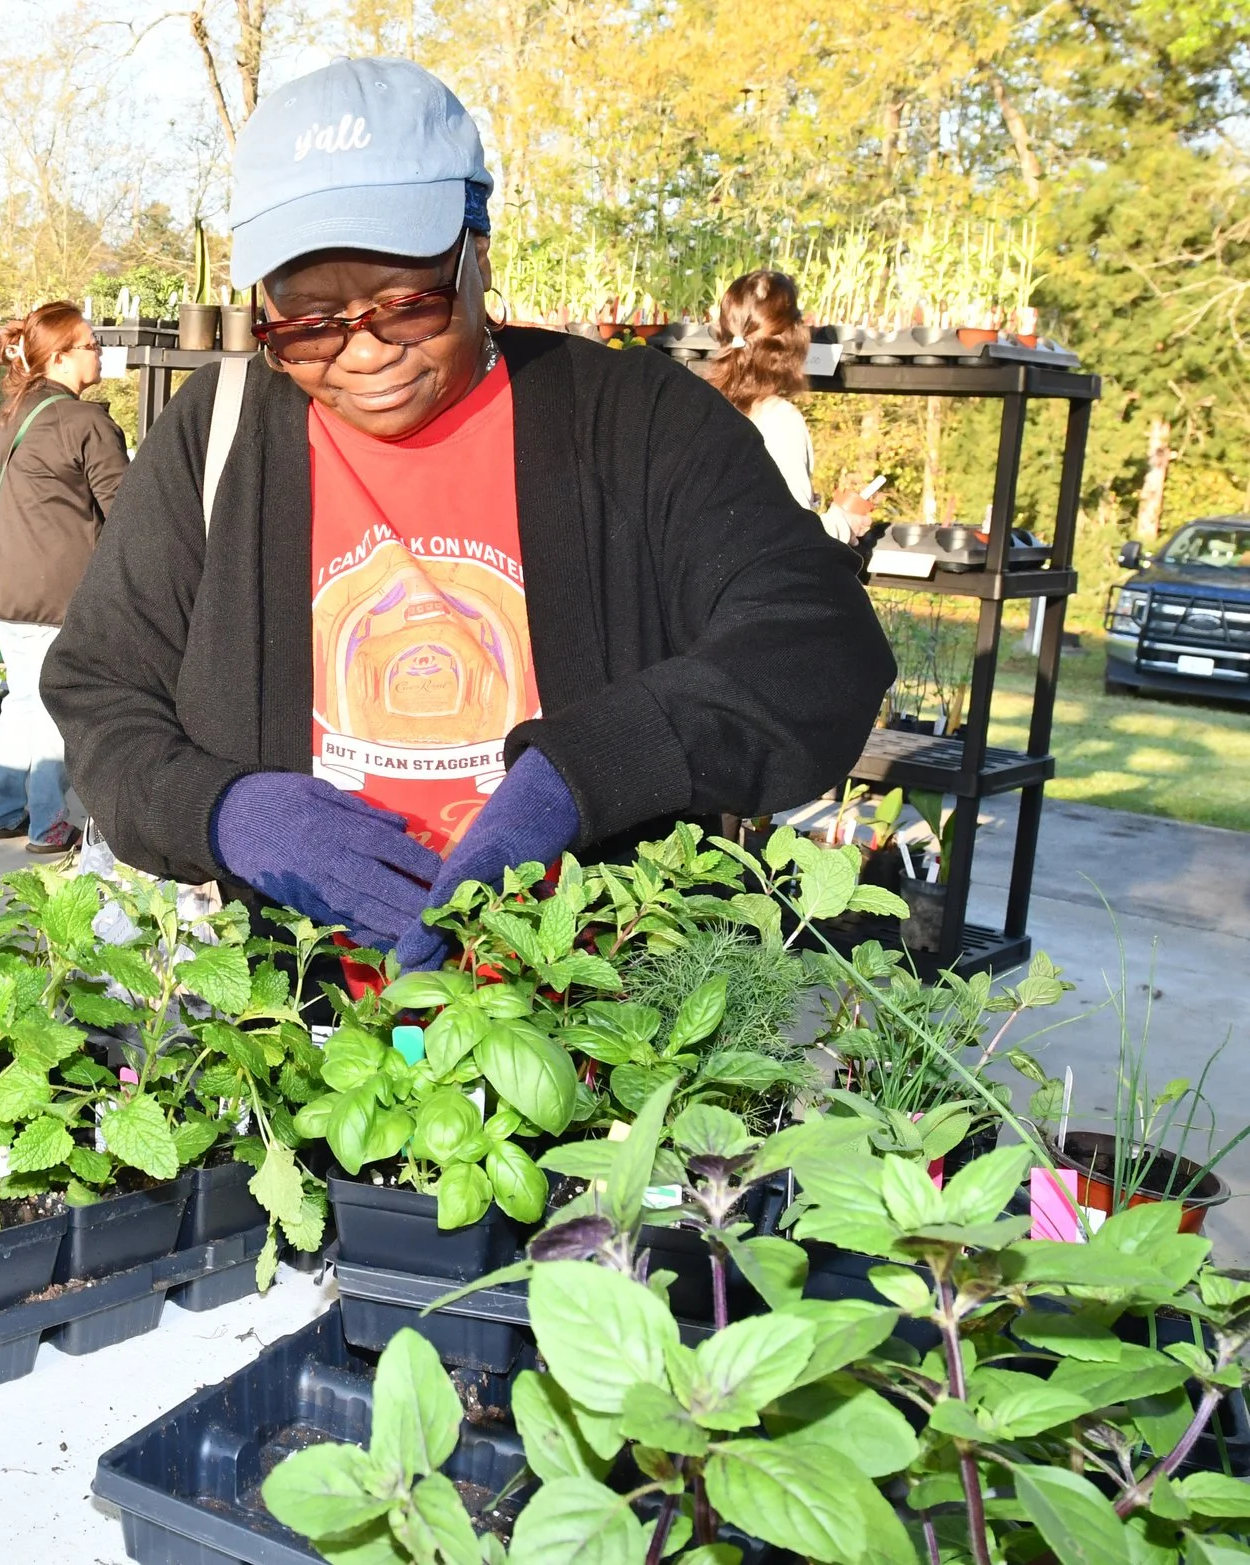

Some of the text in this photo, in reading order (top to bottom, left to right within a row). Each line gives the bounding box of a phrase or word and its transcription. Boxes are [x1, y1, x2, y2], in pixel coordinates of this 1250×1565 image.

[294, 114, 371, 161] y'all
[373, 524, 425, 554] WK
[430, 536, 460, 556] ON
[326, 742, 357, 761] BUT
[374, 755, 409, 771] CAN
[413, 754, 491, 771] STAGGER
